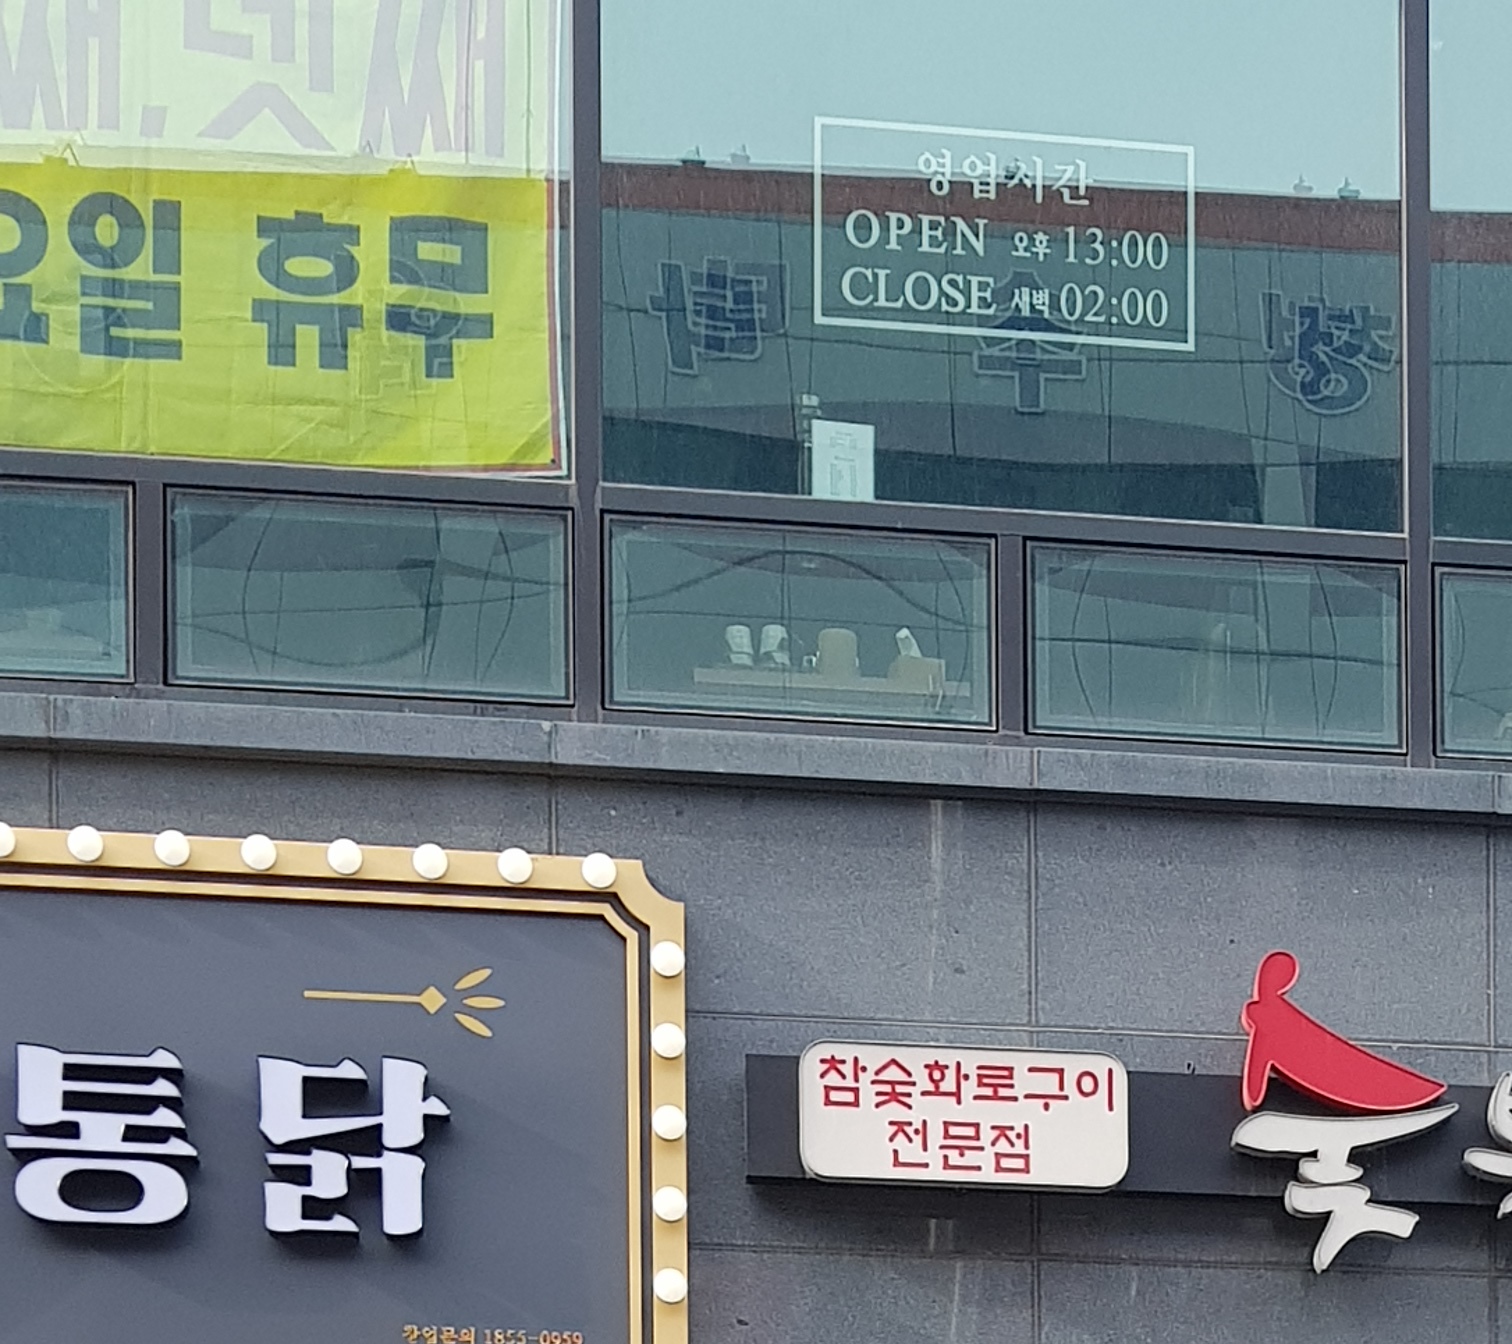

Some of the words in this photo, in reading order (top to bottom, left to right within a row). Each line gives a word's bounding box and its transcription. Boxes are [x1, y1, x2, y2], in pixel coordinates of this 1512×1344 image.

[917, 148, 1093, 205] 영업시간
[845, 208, 988, 257] OPEN
[1010, 231, 1052, 262] 오후
[1063, 226, 1168, 270] 13:00
[252, 210, 493, 380] 휴무
[841, 266, 997, 315] CLOSE
[1010, 287, 1050, 318] 새벽
[1060, 282, 1168, 327] 02:00
[817, 1053, 1116, 1113] 참숯화로구이
[5, 1042, 451, 1237] 통닭
[887, 1118, 1033, 1175] 전문점
